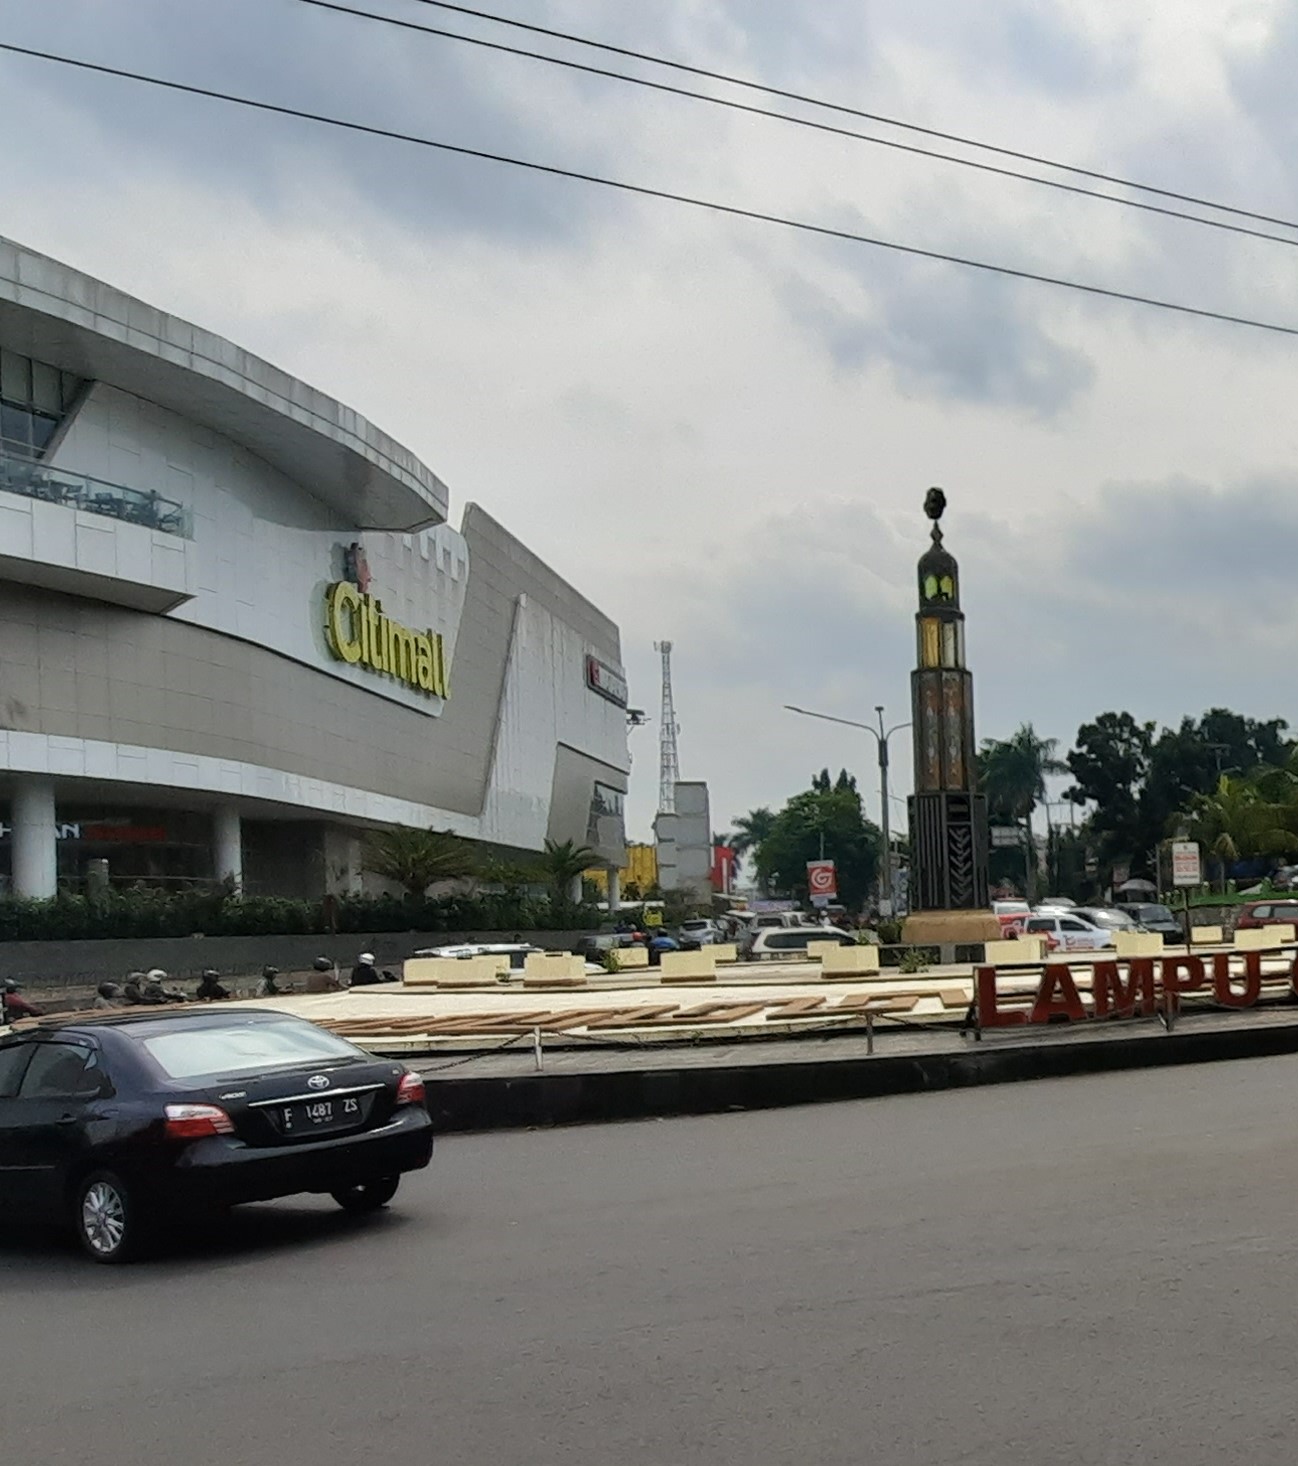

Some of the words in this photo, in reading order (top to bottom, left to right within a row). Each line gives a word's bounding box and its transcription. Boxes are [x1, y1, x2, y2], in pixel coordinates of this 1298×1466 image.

[329, 580, 450, 700] Citimall
[977, 951, 1262, 1028] LAMPU
[284, 1108, 293, 1122] F
[343, 1098, 359, 1114] ZS
